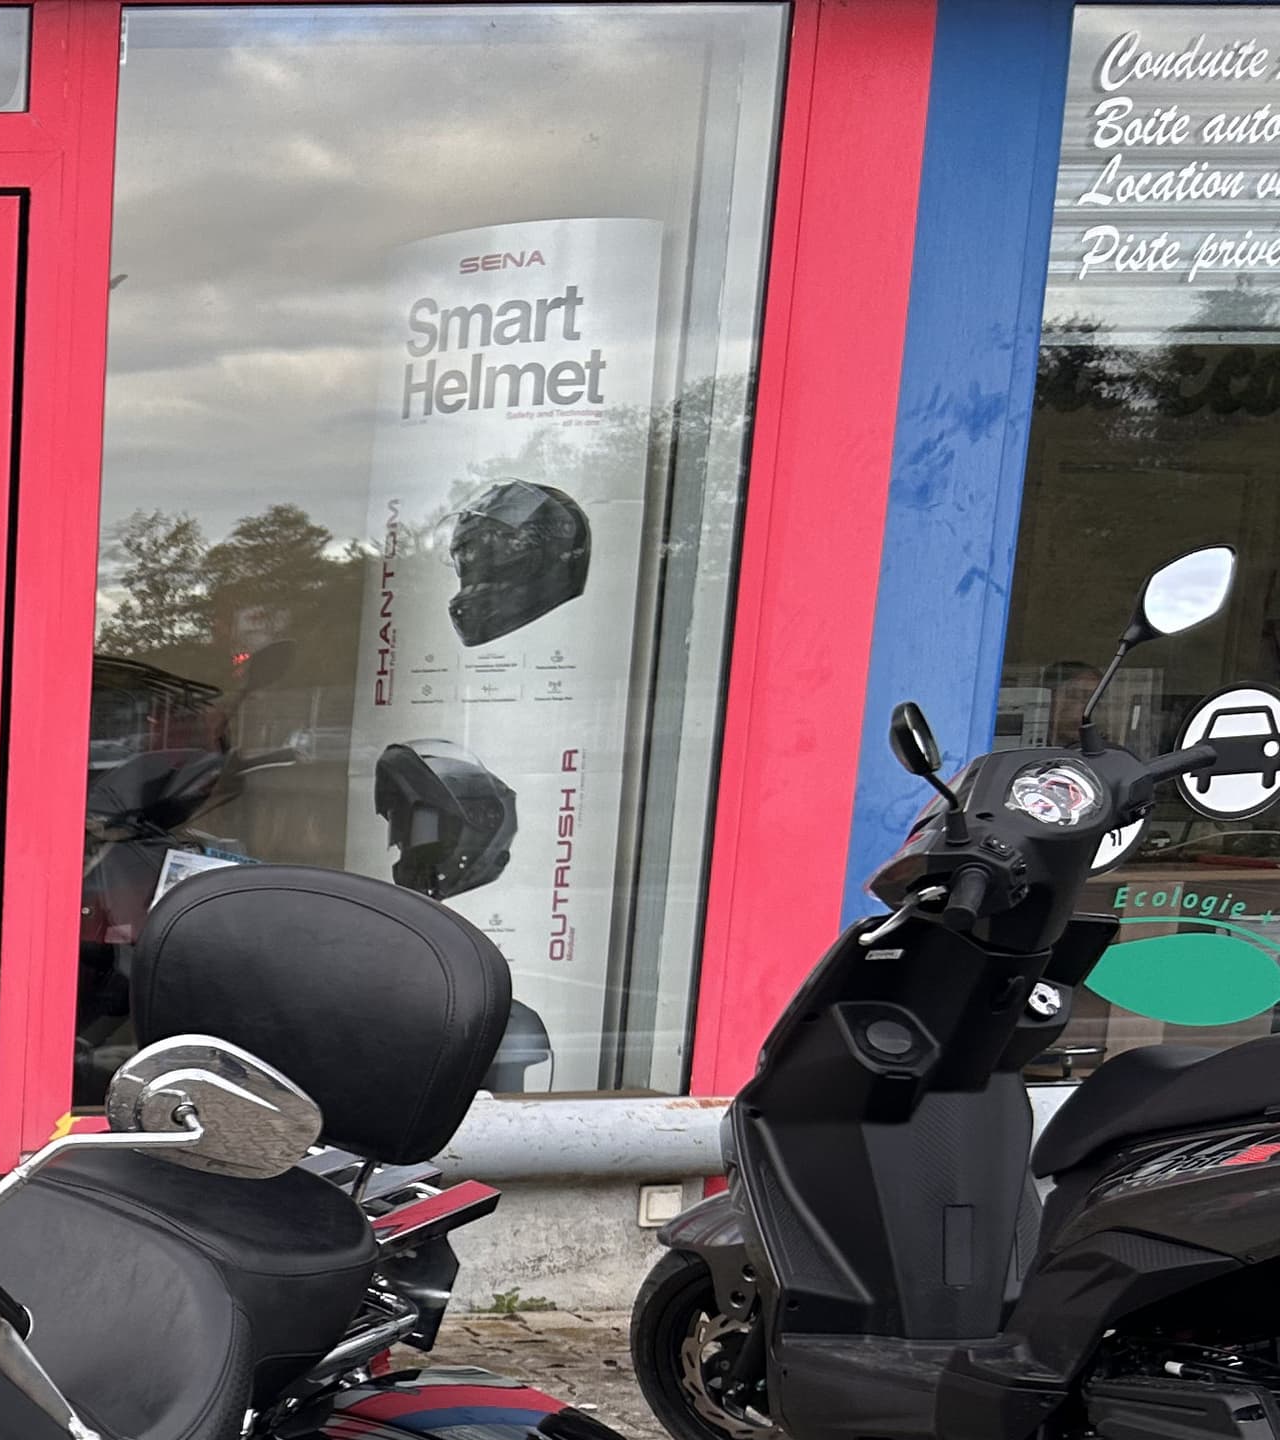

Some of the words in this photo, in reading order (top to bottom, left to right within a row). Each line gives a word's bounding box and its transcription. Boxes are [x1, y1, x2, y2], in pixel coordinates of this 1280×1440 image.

[1100, 30, 1269, 92] Conduite
[1094, 96, 1190, 149] Boite
[1076, 152, 1244, 206] Location
[459, 250, 546, 275] SENA
[1078, 225, 1181, 280] Piste
[406, 285, 584, 358] Smart
[401, 349, 607, 420] Helmet
[375, 499, 400, 706] PHANTOM
[549, 788, 577, 961] OUTRUSH
[1113, 886, 1247, 918] Ecologie
